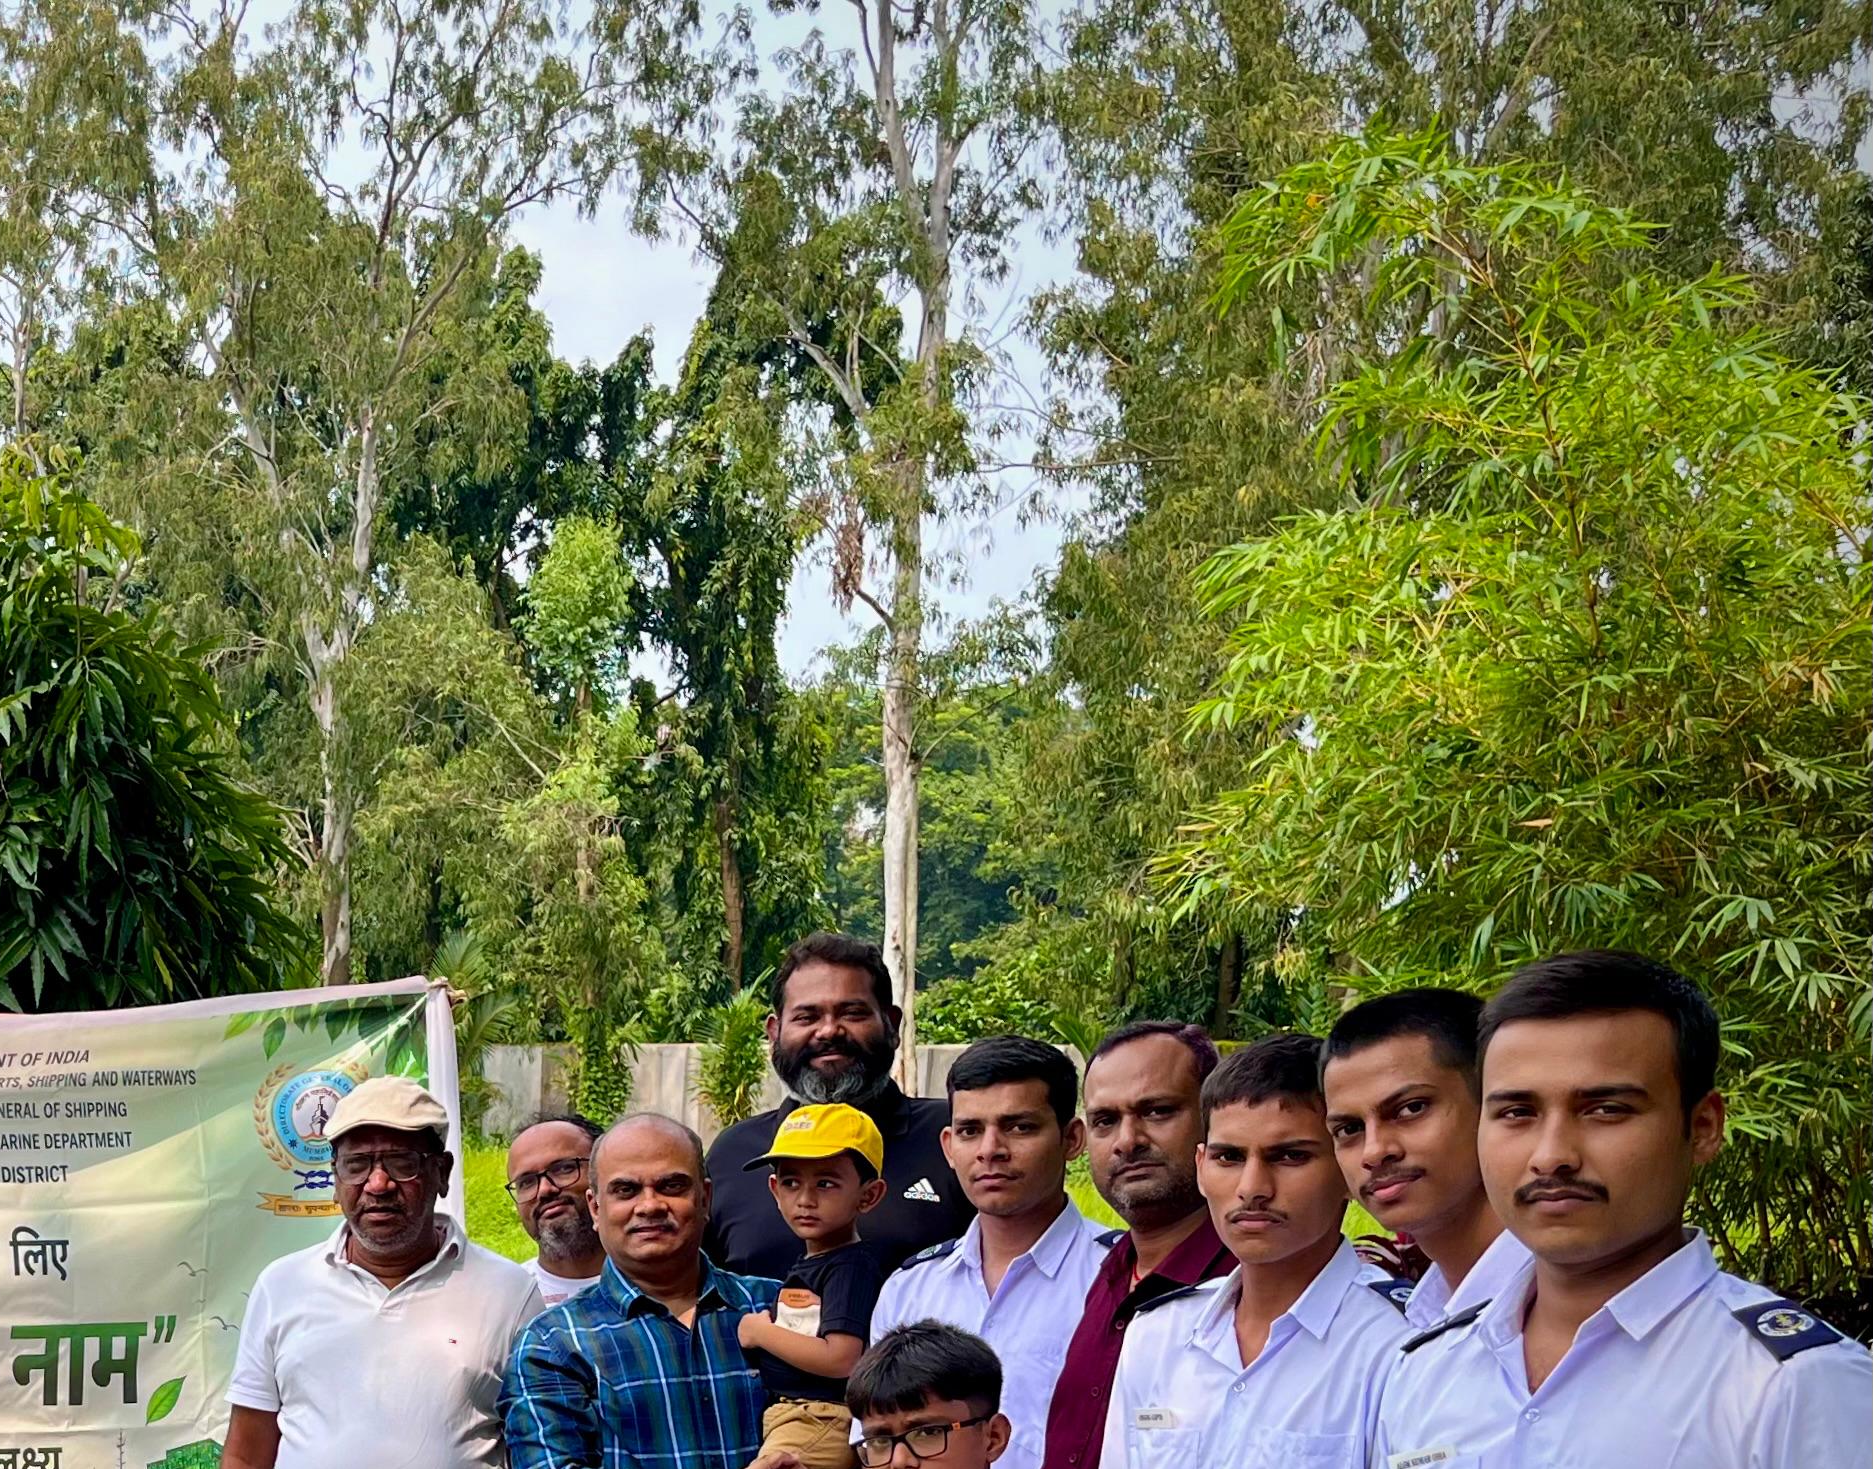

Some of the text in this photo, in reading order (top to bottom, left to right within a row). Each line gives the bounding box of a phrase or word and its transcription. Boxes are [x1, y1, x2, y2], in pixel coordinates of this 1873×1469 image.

[20, 1052, 43, 1066] OF
[45, 1050, 90, 1065] INDIA
[27, 1072, 86, 1088] SHIPPING
[92, 1070, 118, 1086] AND
[121, 1069, 197, 1086] WATERWAYS
[43, 1102, 61, 1119] OF
[65, 1101, 128, 1118] SHIPPING
[43, 1131, 132, 1149] DEPARTMENT
[1, 1165, 68, 1183] DISTRICT
[9, 1226, 69, 1281] लिए
